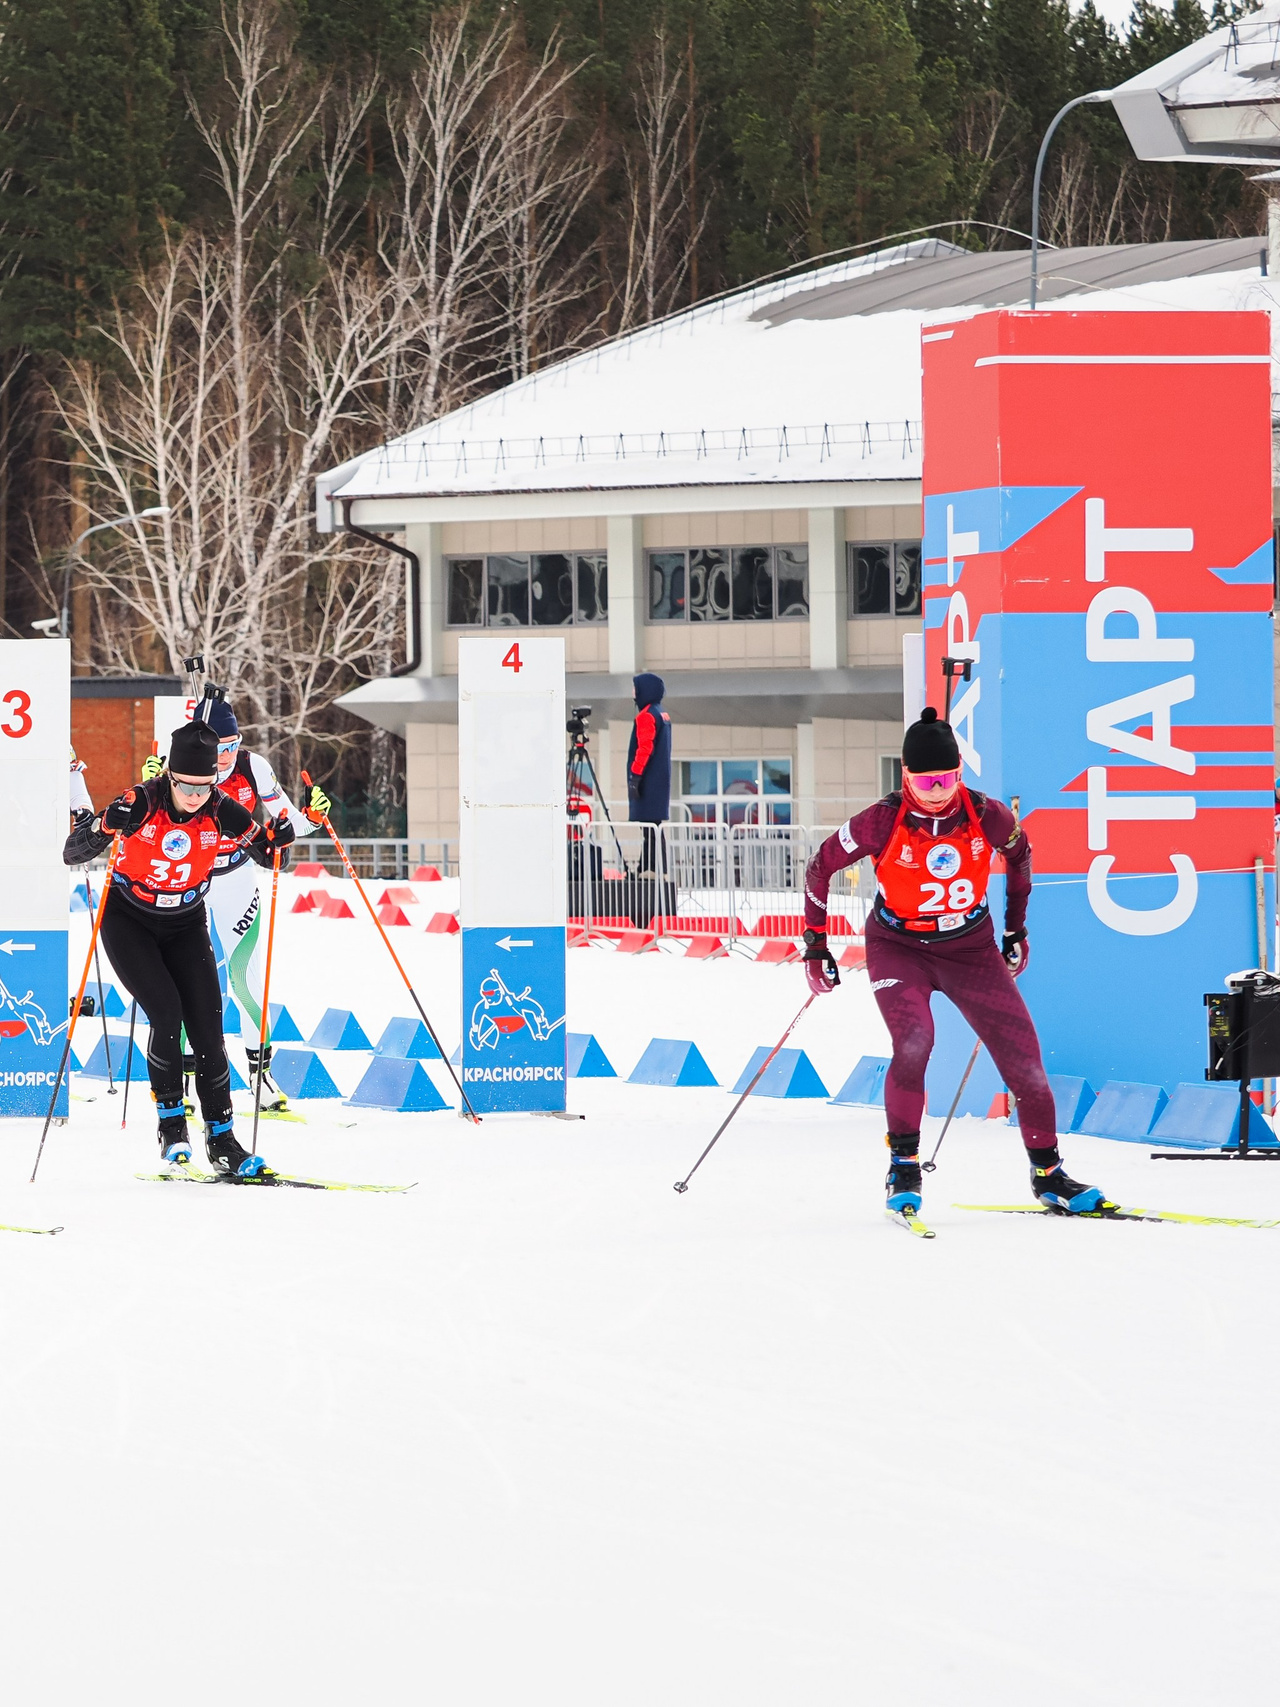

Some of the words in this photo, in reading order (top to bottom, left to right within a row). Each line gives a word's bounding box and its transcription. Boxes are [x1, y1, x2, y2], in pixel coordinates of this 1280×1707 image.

[946, 504, 981, 777] АРТ
[502, 643, 523, 672] 4
[1, 690, 32, 738] 3
[185, 700, 196, 720] 5
[1084, 497, 1199, 936] СТАРТ
[147, 858, 192, 885] 31
[918, 879, 975, 912] 28
[464, 1066, 564, 1082] КРАСНОЯРСК
